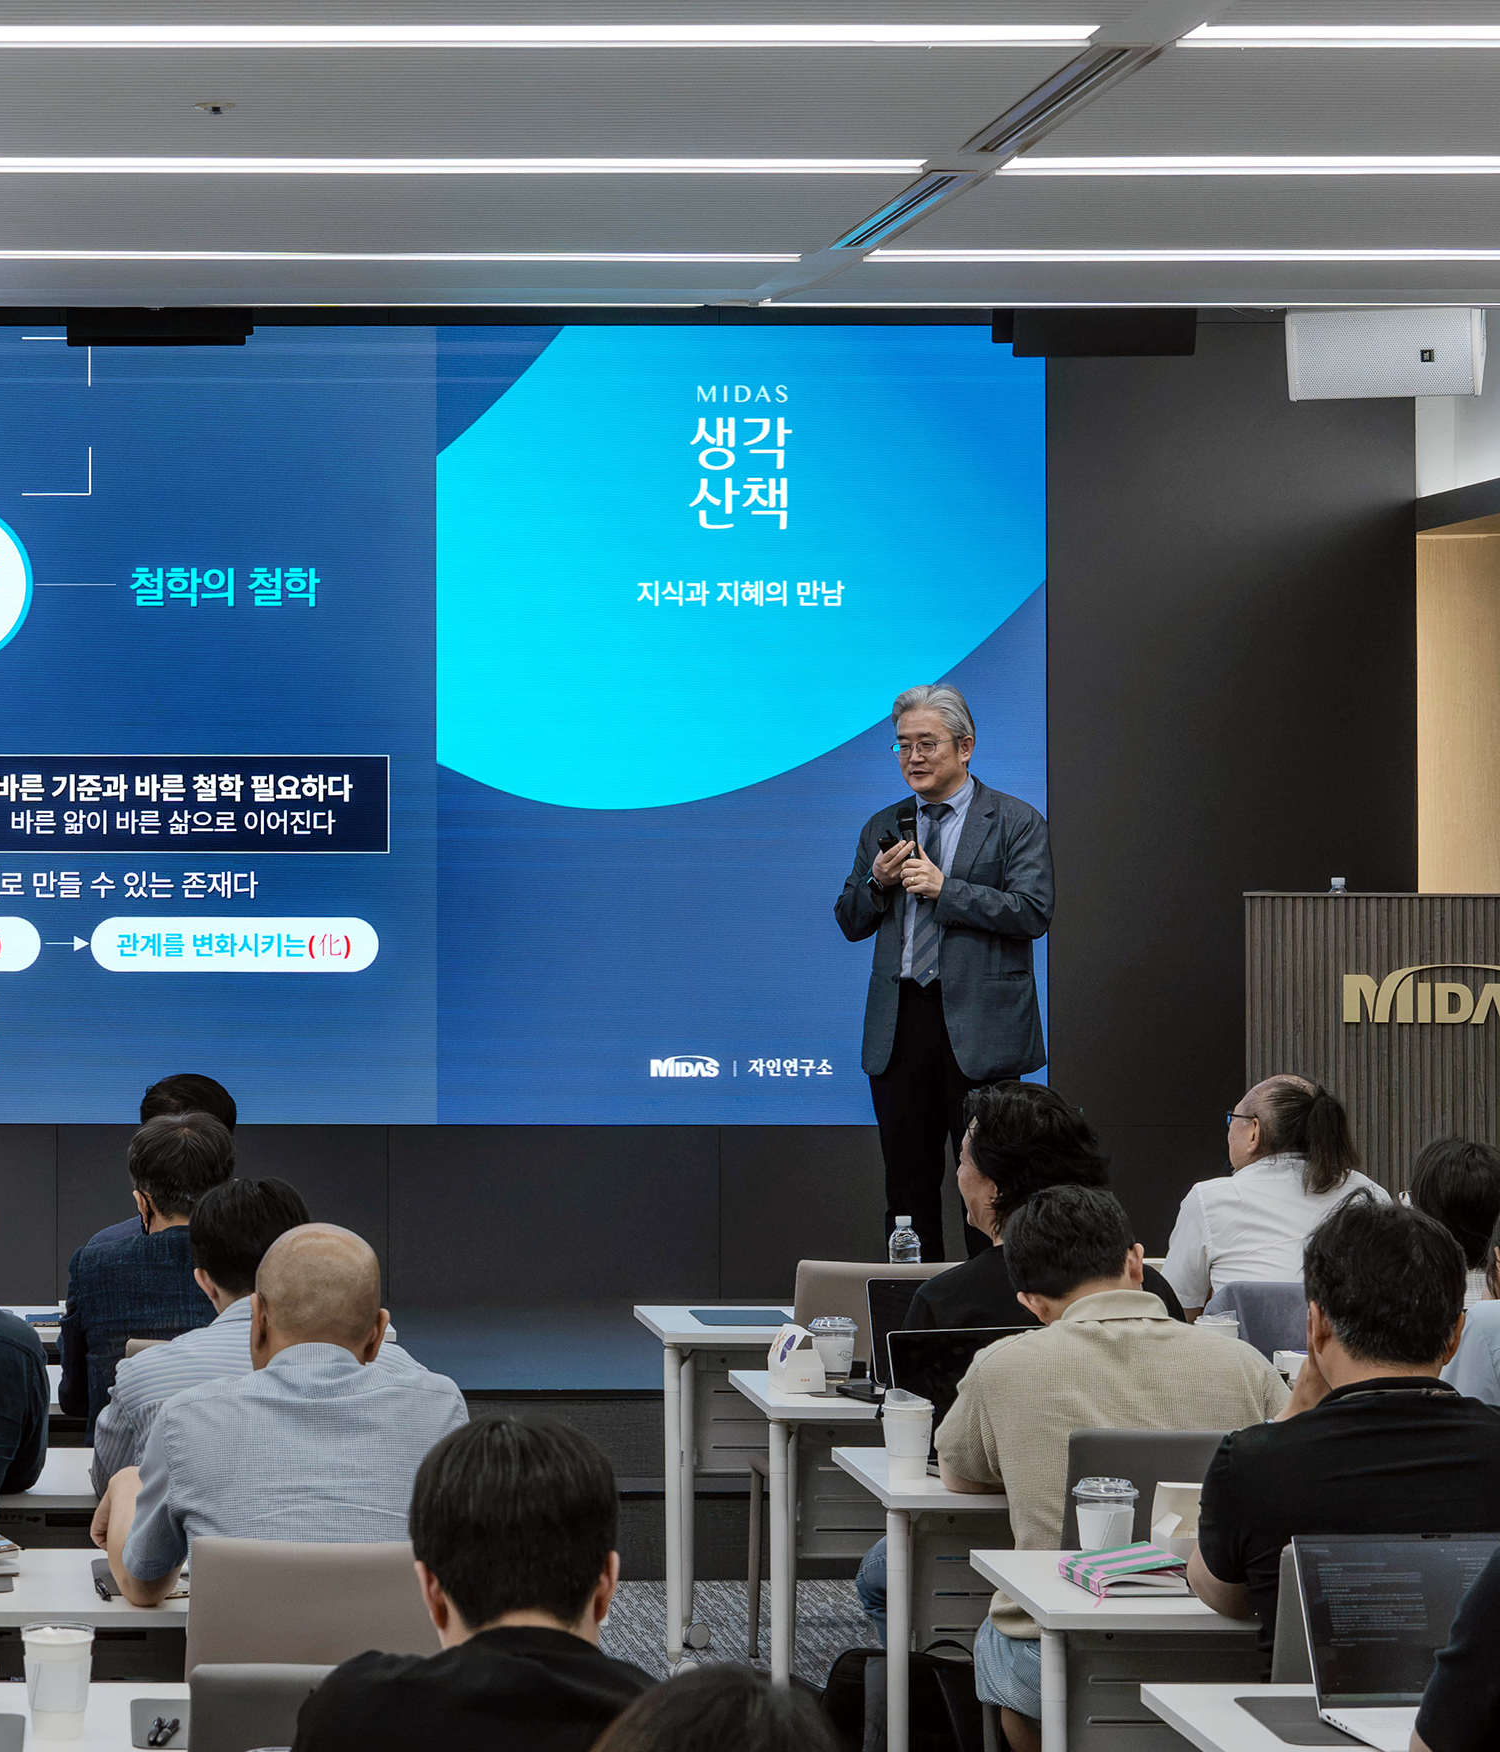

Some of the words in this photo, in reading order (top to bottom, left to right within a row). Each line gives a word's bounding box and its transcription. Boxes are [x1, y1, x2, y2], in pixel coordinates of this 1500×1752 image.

[697, 384, 789, 404] MIDAS
[689, 417, 793, 471] 생각
[688, 477, 788, 530] 산책
[129, 567, 235, 607] 철학의
[247, 567, 321, 607] 철학
[636, 580, 711, 607] 지식과
[716, 579, 788, 607] 지혜의
[796, 580, 846, 607] 만남
[51, 773, 129, 803] 기준과
[134, 773, 186, 803] 바른
[192, 773, 245, 803] 철학
[250, 773, 354, 803] 필요하다
[11, 809, 57, 835] 바른
[63, 809, 107, 835] 앎이
[116, 809, 162, 835] 바른
[167, 809, 237, 835] 삶으로
[244, 809, 337, 836] 이어진다
[32, 870, 83, 899] 만들
[90, 871, 116, 899] 수
[123, 870, 175, 899] 있는
[181, 870, 259, 899] 존재다
[116, 932, 186, 958] 관계를
[1343, 964, 1500, 1025] MIDA
[649, 1055, 720, 1078] MIDAS
[747, 1058, 833, 1077] 자인연구소
